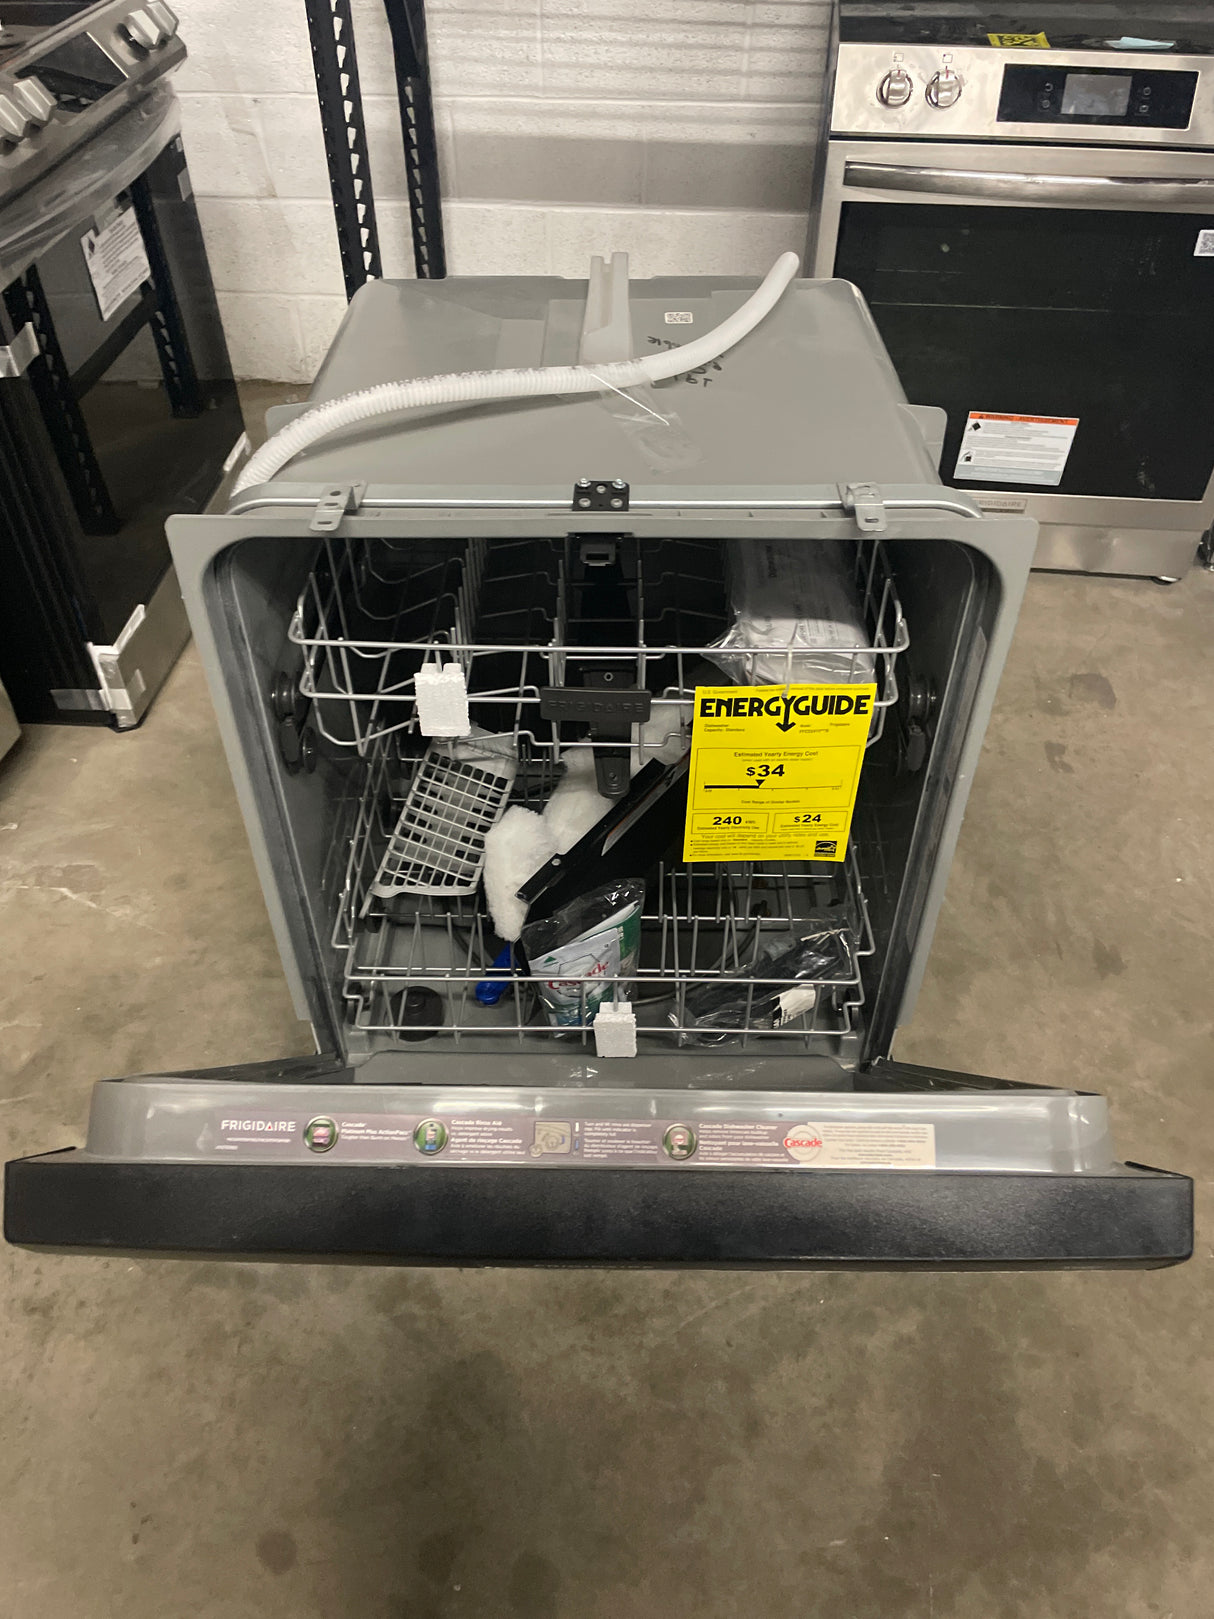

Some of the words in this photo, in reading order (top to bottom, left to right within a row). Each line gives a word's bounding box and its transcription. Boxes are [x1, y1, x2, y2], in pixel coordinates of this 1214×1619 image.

[700, 694, 871, 718] ENERGYGUIDE
[746, 764, 785, 777] $34
[712, 816, 742, 825] 240
[794, 814, 822, 823] $24
[221, 1120, 297, 1132] FRIGIDAIRE
[784, 1137, 823, 1149] Cascade
